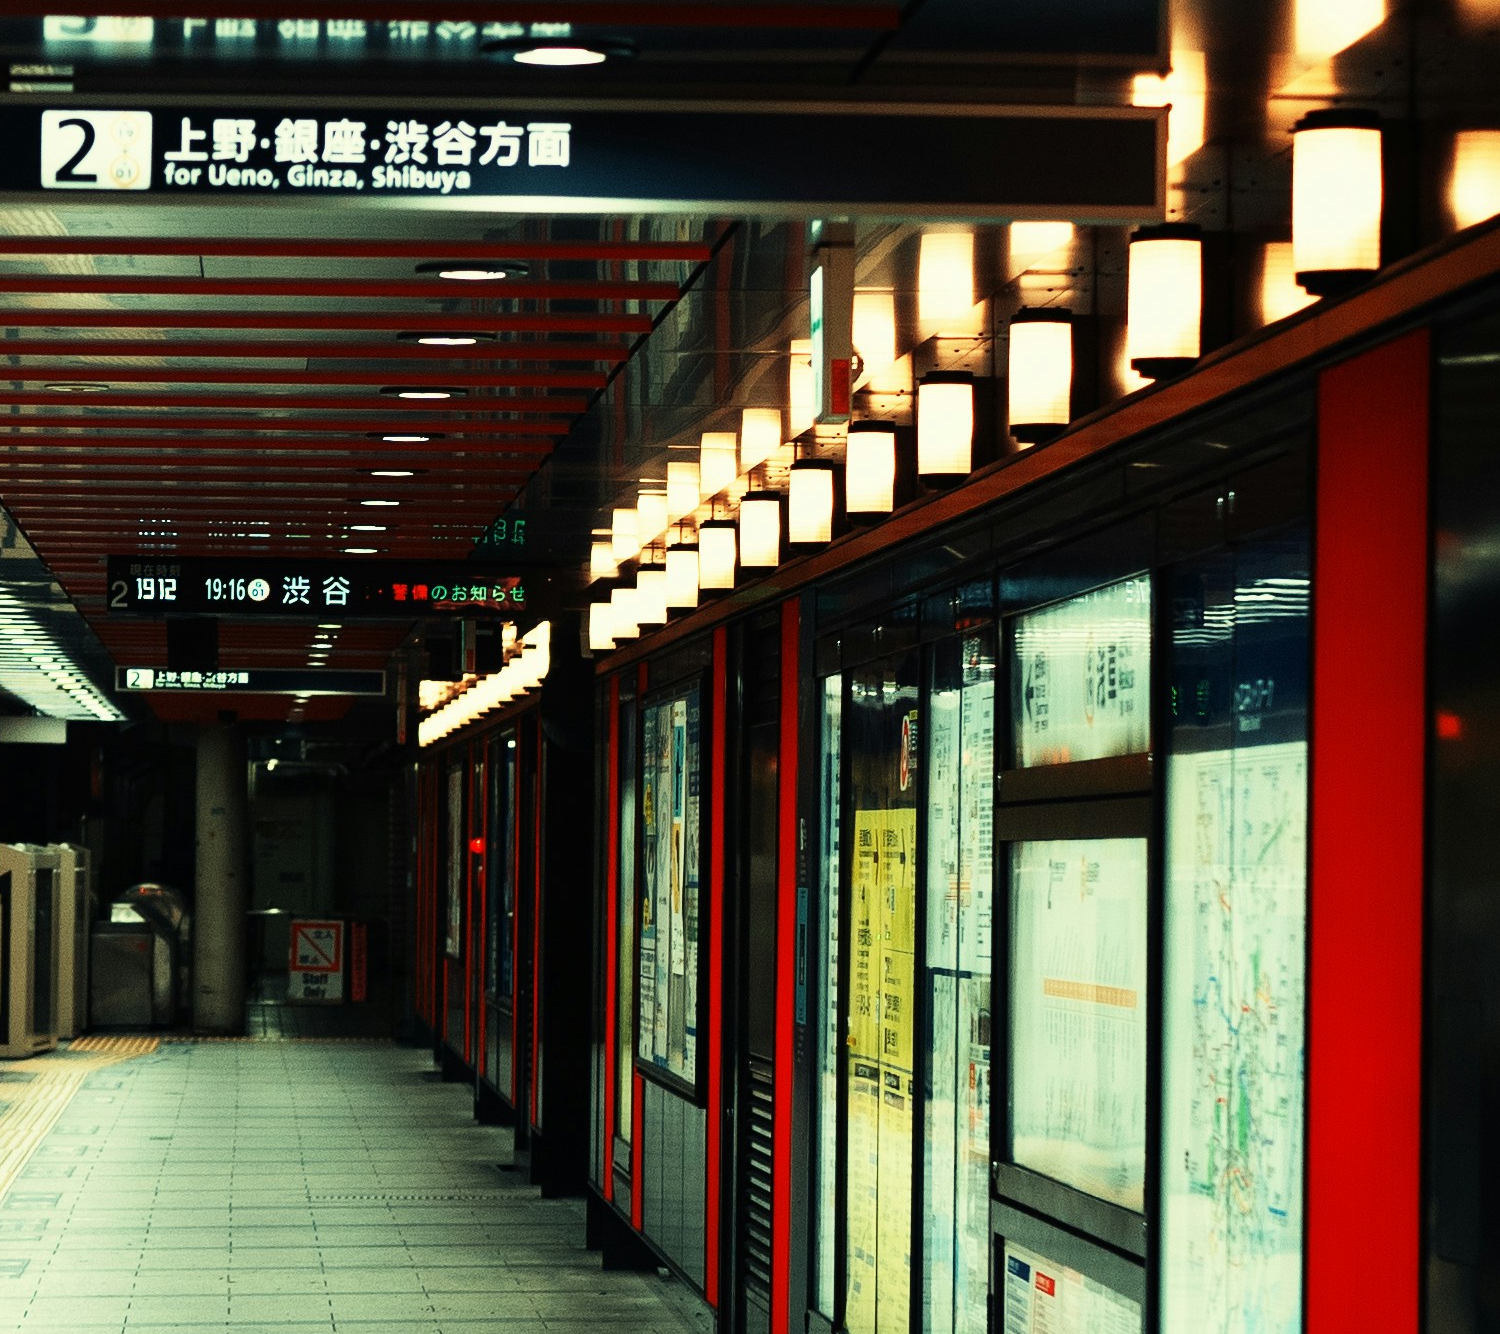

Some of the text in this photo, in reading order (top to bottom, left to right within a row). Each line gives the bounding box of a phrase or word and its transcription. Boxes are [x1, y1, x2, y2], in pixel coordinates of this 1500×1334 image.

[55, 118, 98, 183] 2
[163, 162, 471, 194] for Ueno, Ginza, Shibuya
[110, 580, 128, 608] 2
[205, 578, 246, 601] 19:16
